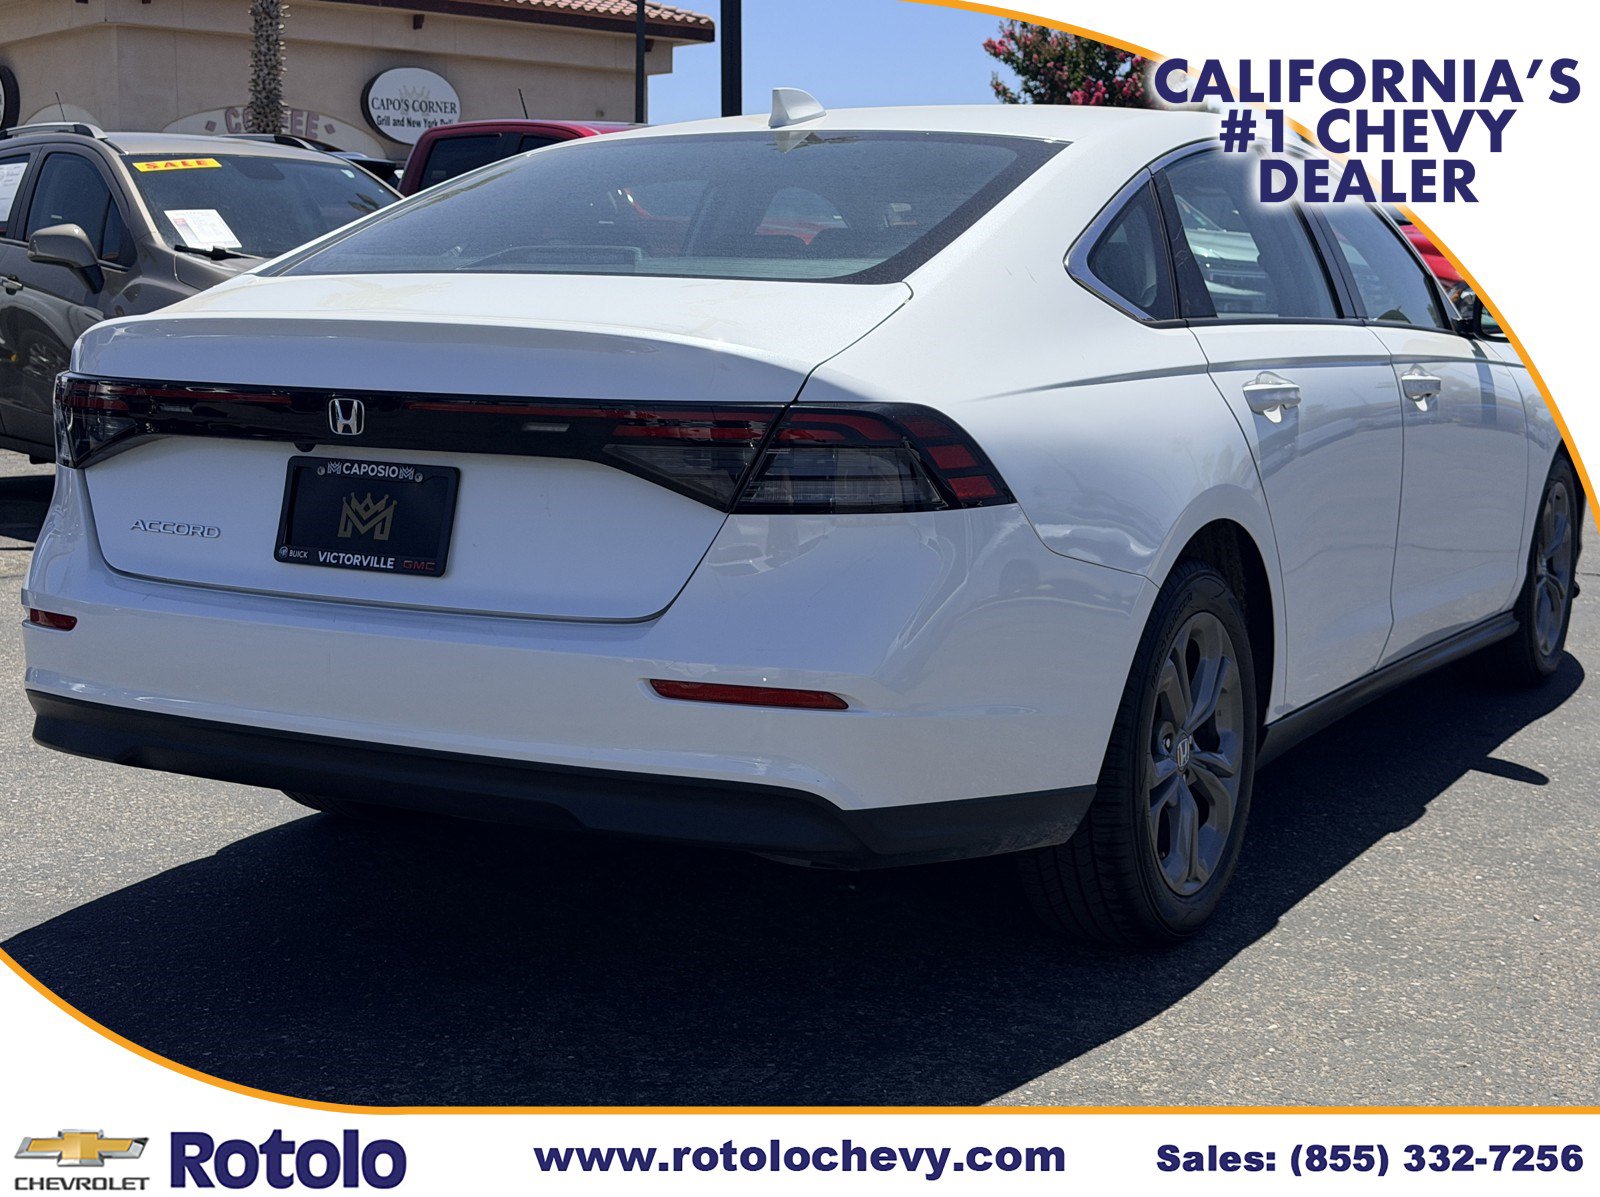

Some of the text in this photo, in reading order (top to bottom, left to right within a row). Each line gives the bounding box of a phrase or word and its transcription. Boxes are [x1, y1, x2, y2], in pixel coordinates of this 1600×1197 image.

[371, 97, 457, 114] CAPO'S CORNER
[225, 107, 319, 139] COEE
[376, 115, 391, 127] Grill
[392, 116, 405, 127] and
[406, 117, 421, 128] New
[145, 160, 209, 169] SALE
[343, 462, 399, 478] CAPOSIO
[130, 519, 221, 538] ACCORD
[289, 549, 435, 571] BUICK VICTORVILLE GMC
